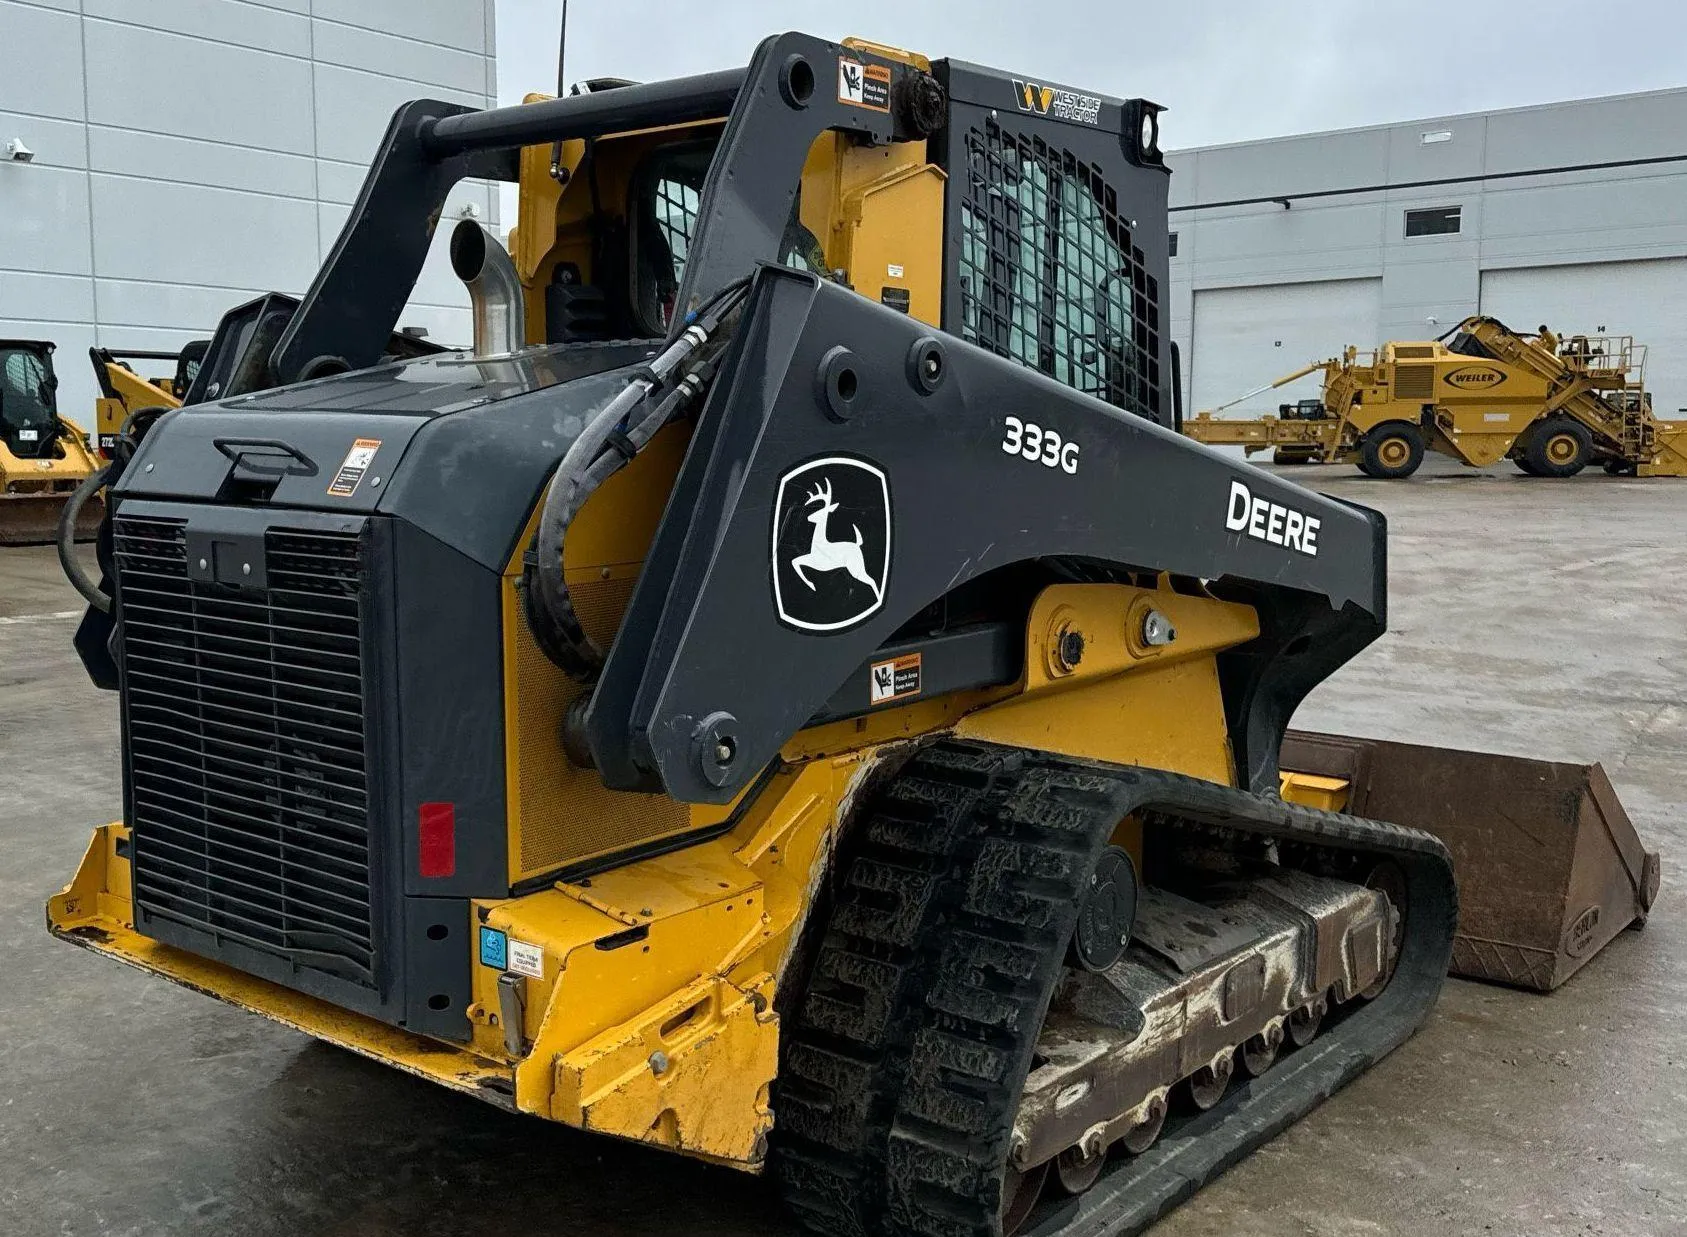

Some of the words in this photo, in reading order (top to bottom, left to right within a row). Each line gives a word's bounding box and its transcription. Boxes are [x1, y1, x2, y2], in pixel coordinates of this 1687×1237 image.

[1053, 102, 1098, 125] TRACTOR
[1455, 373, 1496, 383] WEILER
[1001, 416, 1081, 475] 333G
[1225, 480, 1321, 556] DEERE
